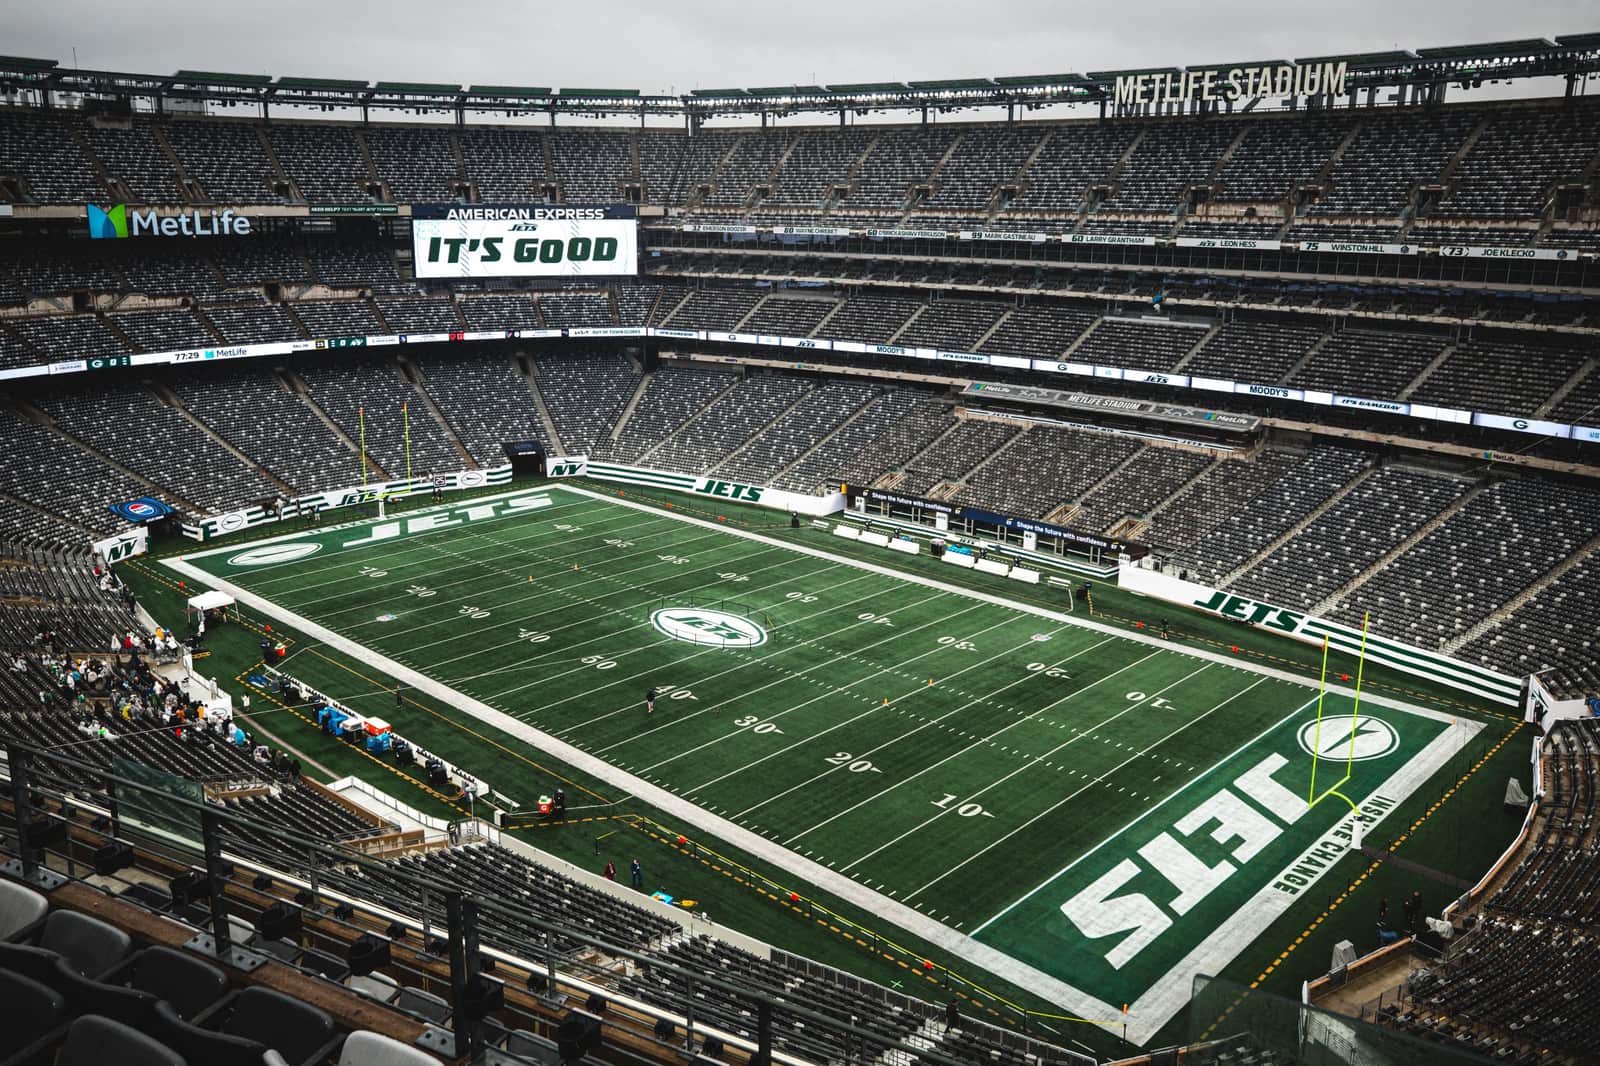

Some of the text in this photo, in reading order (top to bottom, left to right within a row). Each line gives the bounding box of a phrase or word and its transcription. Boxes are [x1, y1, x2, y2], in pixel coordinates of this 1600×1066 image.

[1114, 71, 1218, 104] METLIFE
[1226, 62, 1347, 100] STADIUM
[447, 208, 604, 220] AMERICAN EXPRESS
[133, 209, 250, 238] MetLife
[428, 237, 618, 264] IT'S GOOD
[1304, 242, 1385, 252] 75 WINSTON HILL
[1449, 247, 1536, 258] 73 JOE KLECKO
[175, 352, 200, 360] 77:29
[216, 348, 247, 358] MetLife
[877, 346, 906, 355] MOODY'S
[1144, 374, 1168, 384] JETS
[1250, 385, 1289, 398] MOODY'S
[1068, 395, 1140, 410] METLIFE STADIUM
[1217, 414, 1248, 424] MetLife
[1493, 454, 1516, 462] MetLife
[550, 464, 584, 476] NY
[336, 490, 378, 506] JETS
[696, 480, 764, 502] JETS
[897, 496, 912, 505] future
[925, 503, 952, 513] confidence
[343, 494, 553, 548] JETS
[1016, 522, 1034, 531] Shape
[1034, 524, 1044, 532] the
[1044, 526, 1062, 536] future
[1063, 531, 1075, 540] with
[1076, 535, 1107, 548] confidence
[108, 540, 137, 562] NY
[358, 566, 388, 578] 10
[723, 572, 750, 582] 40
[785, 592, 818, 603] 50
[458, 606, 490, 618] 30
[857, 613, 890, 626] 40
[1194, 592, 1305, 632] JETS
[664, 616, 749, 640] JETS
[518, 631, 550, 644] 40
[937, 636, 976, 650] 30
[581, 655, 618, 670] 50
[1026, 662, 1068, 678] 20
[654, 685, 692, 700] 40
[1126, 692, 1172, 710] 10
[734, 715, 777, 734] 30
[824, 752, 873, 774] 20
[931, 793, 984, 818] 10
[1060, 752, 1311, 970] JETS
[1272, 841, 1345, 895] CHANGE
